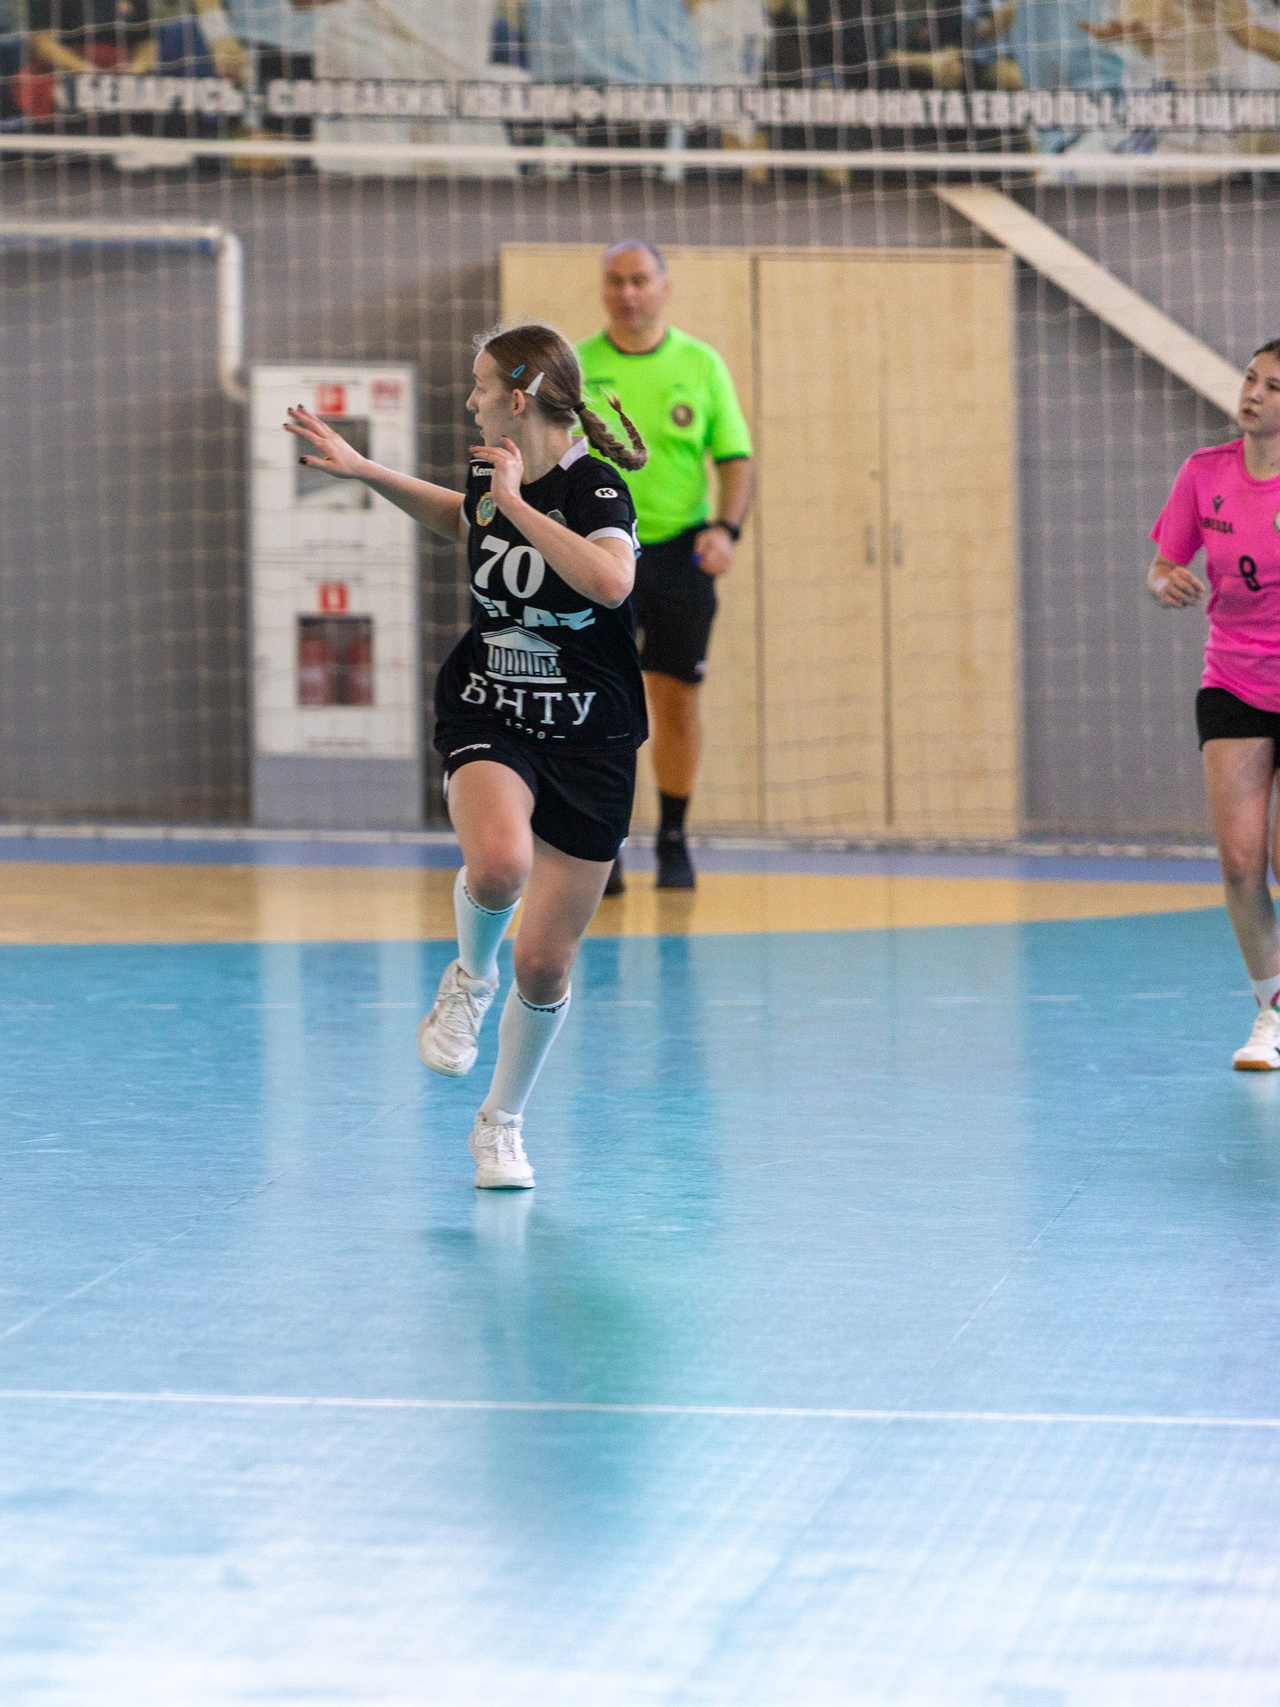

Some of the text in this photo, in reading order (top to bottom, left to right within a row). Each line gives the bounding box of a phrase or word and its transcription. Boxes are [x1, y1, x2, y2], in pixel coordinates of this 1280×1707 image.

[474, 534, 546, 599] 70
[1239, 555, 1262, 592] 8
[460, 672, 597, 726] БНТУ
